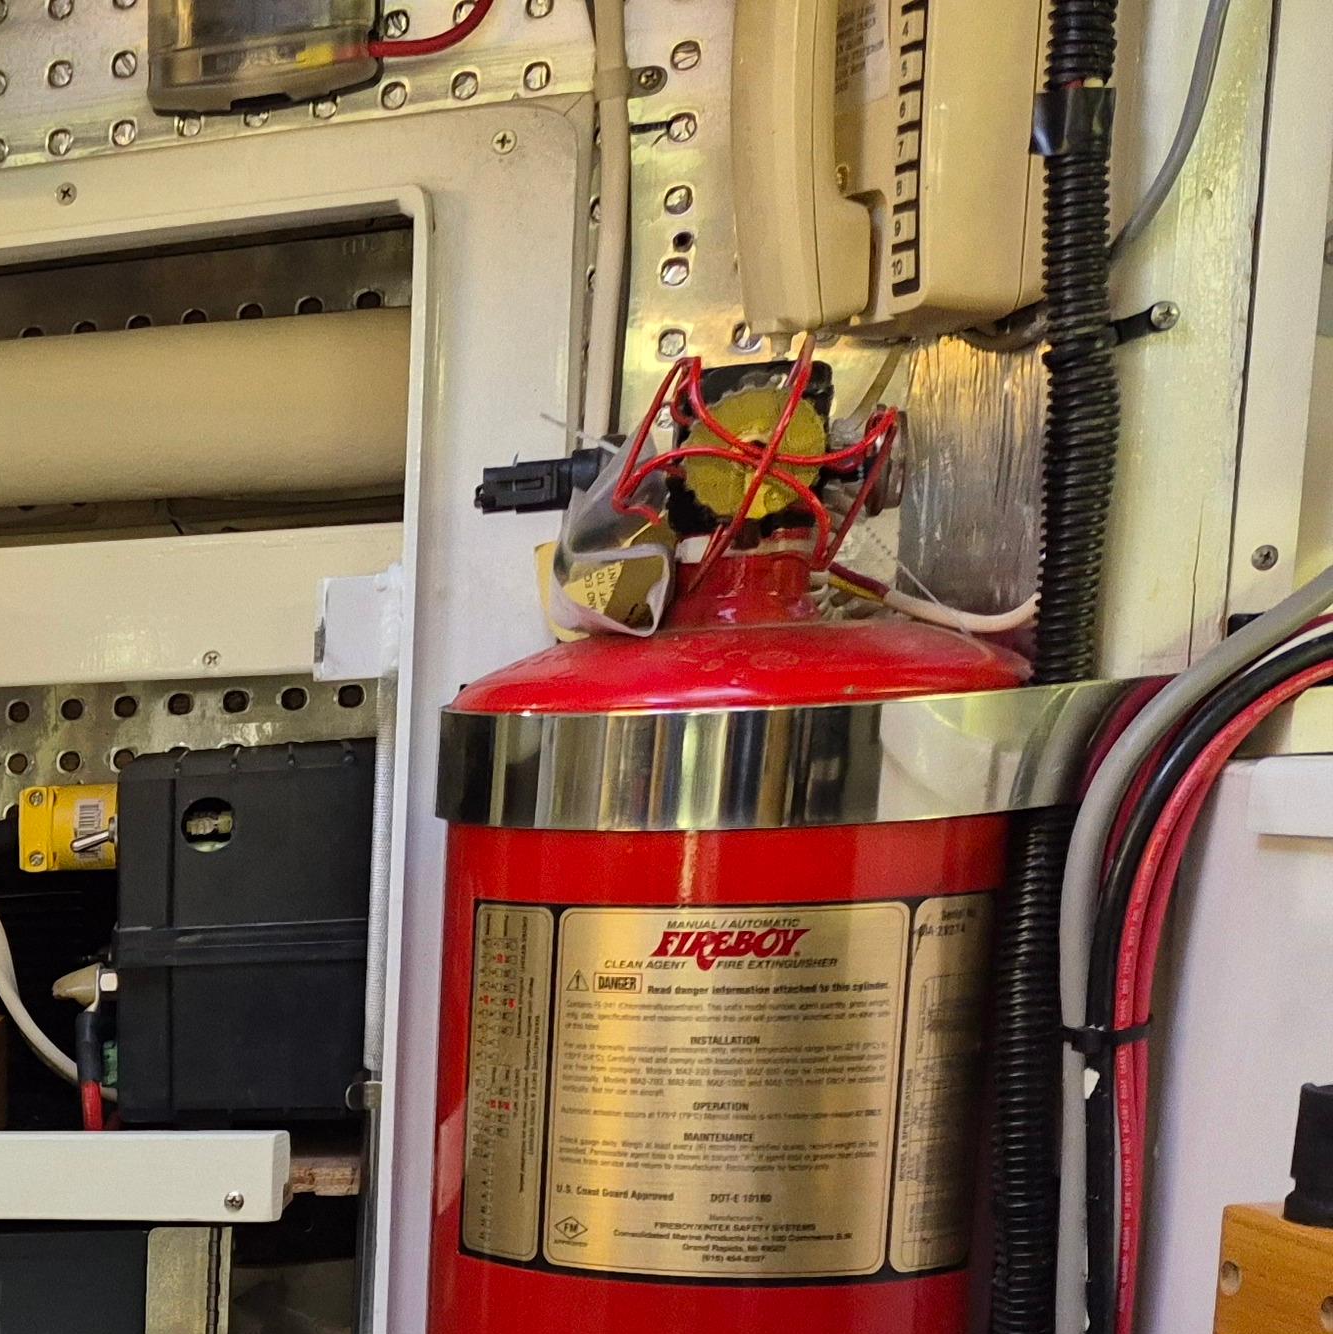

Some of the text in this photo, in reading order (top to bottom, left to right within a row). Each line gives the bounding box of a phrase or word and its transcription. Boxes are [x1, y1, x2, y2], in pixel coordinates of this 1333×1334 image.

[902, 21, 909, 36] 4
[899, 102, 906, 118] 6
[898, 141, 904, 157] 7
[896, 181, 902, 197] 8
[894, 221, 901, 237] 9
[891, 259, 903, 276] 10
[667, 919, 719, 929] MANUAL
[728, 917, 800, 928] AUTOMATIC
[650, 928, 812, 971] FIREBOY
[604, 958, 838, 970] CLEAN AGENT FIRE EXTINGUISHER
[598, 975, 637, 991] DANGER
[648, 985, 671, 994] Read
[674, 985, 708, 996] danger
[711, 984, 770, 995] information
[690, 1036, 760, 1045] INSTALLATION
[692, 1102, 749, 1111] OPERATION
[684, 1133, 754, 1142] MAINTENANCE
